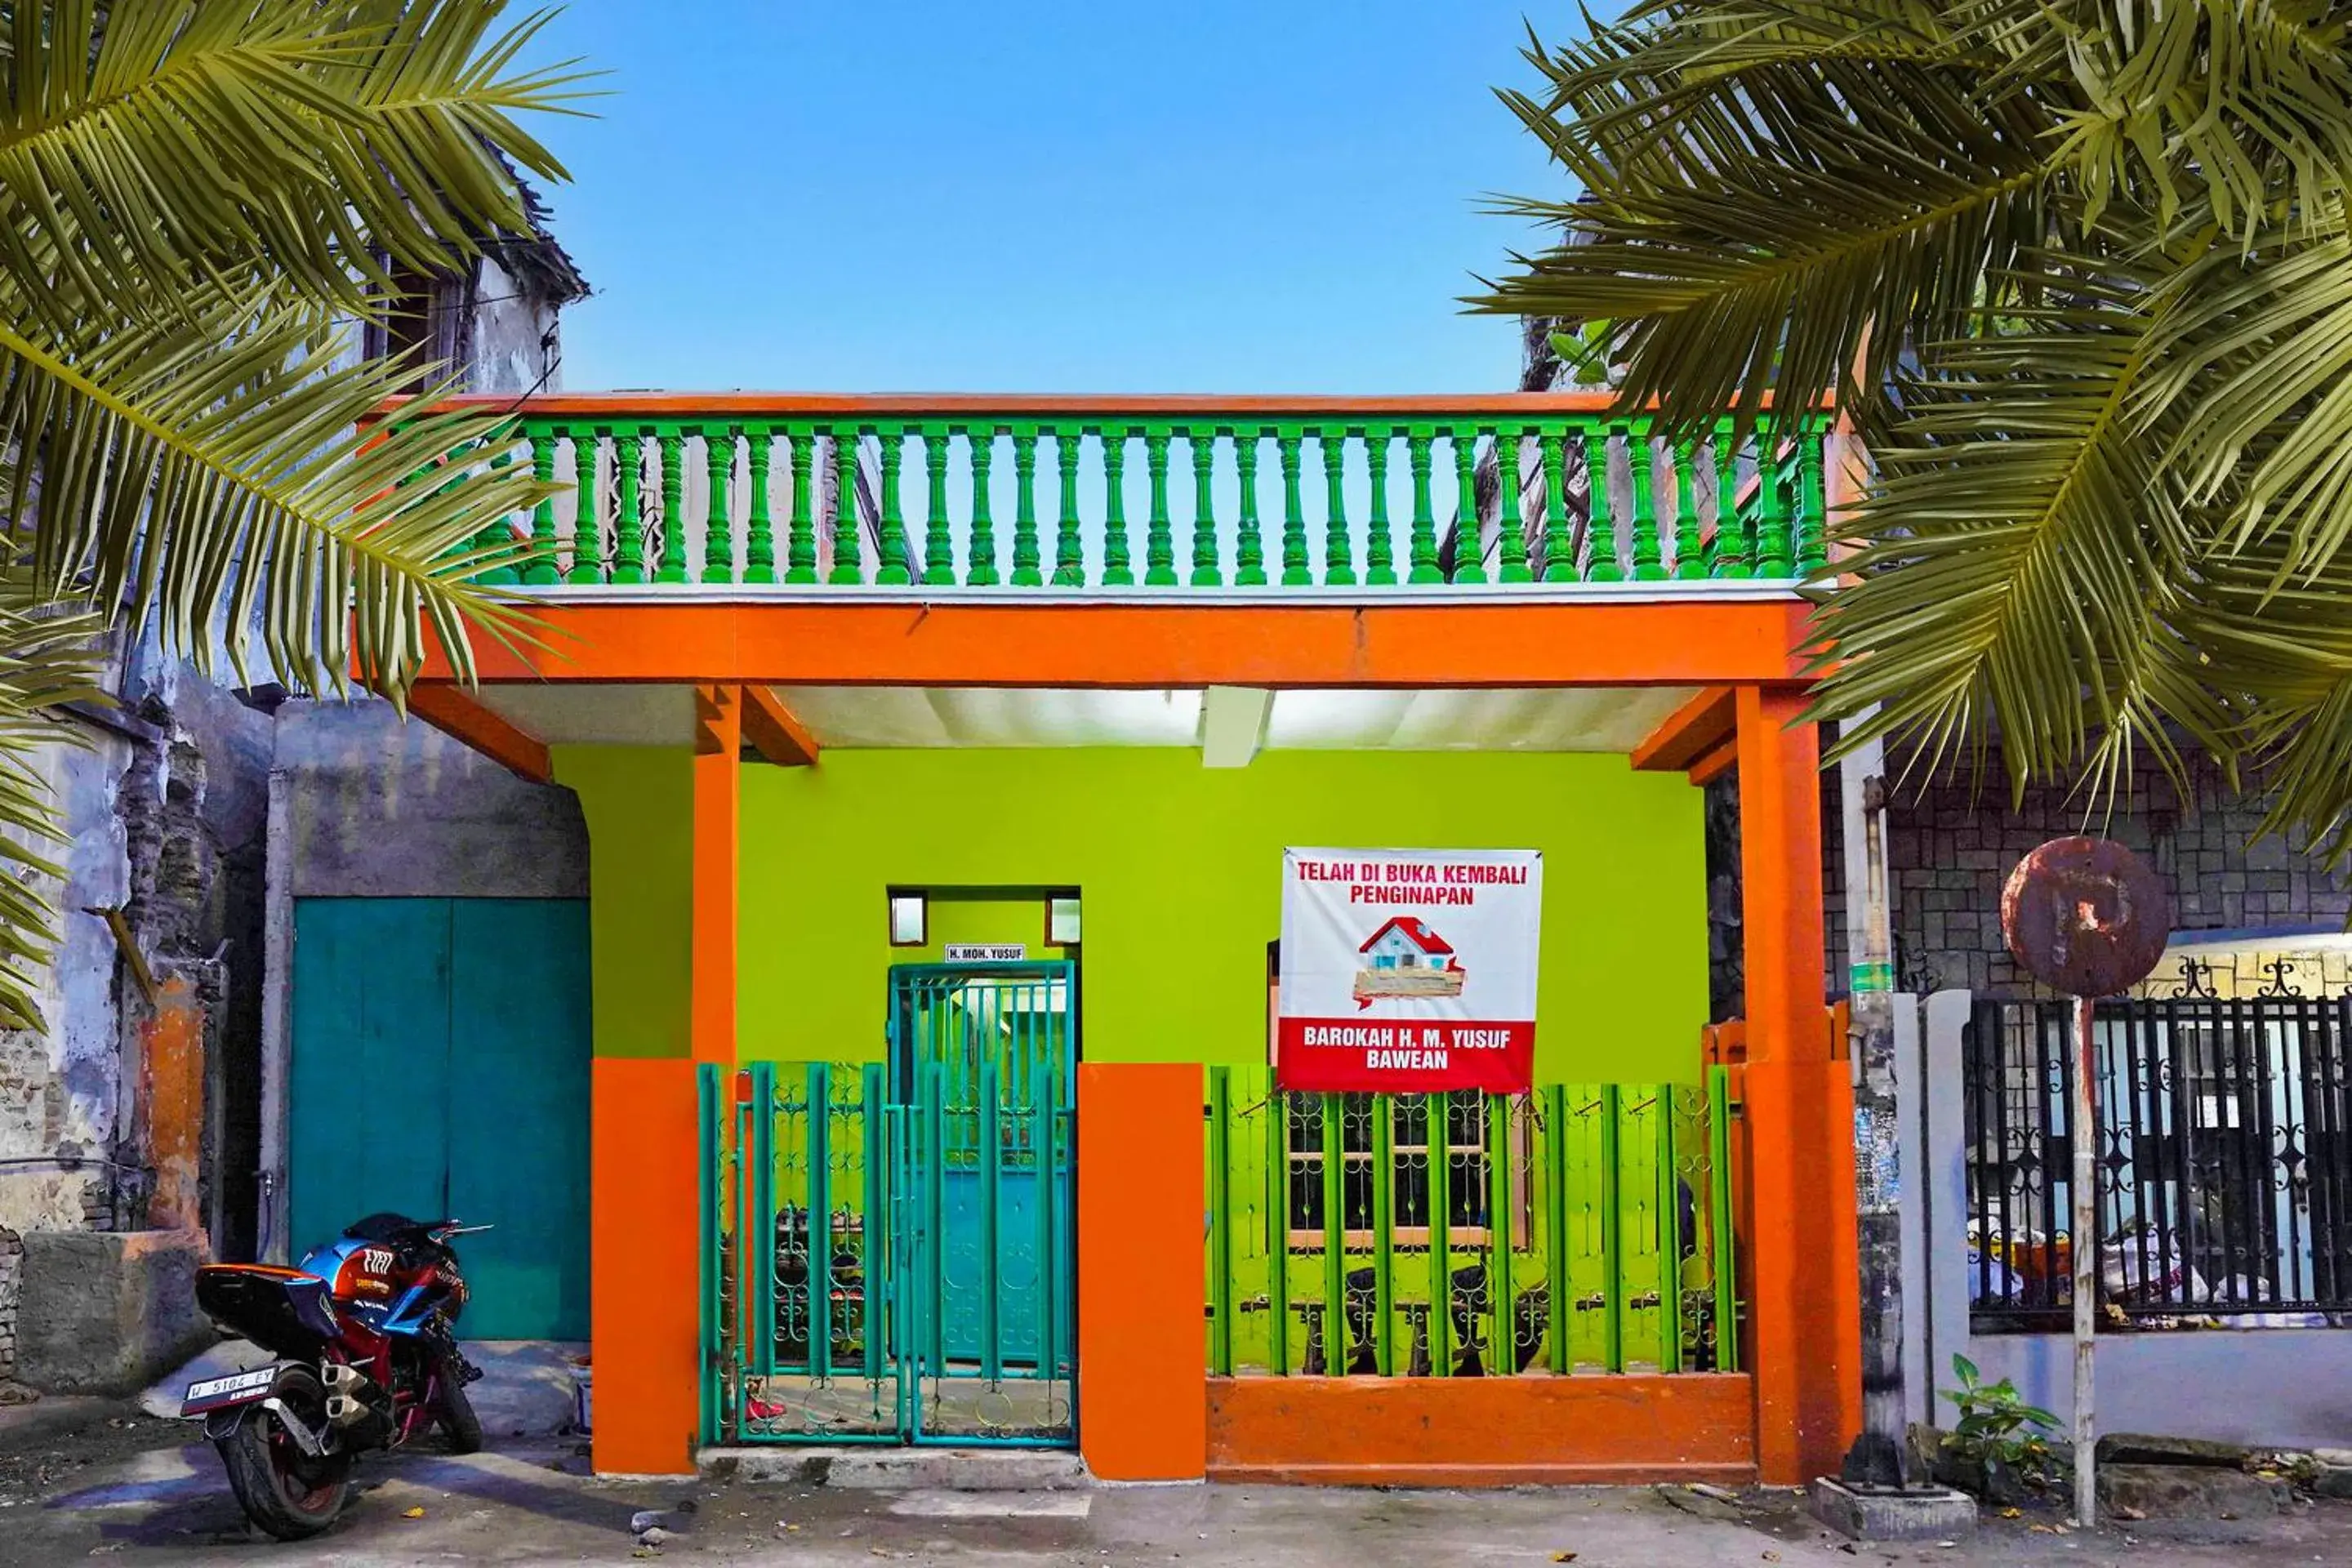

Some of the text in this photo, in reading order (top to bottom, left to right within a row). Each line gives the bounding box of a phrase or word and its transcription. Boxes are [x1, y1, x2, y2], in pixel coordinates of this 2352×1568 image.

[1298, 862, 1526, 884] TELAH DI BUKA KEMBALI
[1350, 884, 1473, 906] PENGINAPAN
[949, 948, 1022, 959] H. MOH. YUSUF
[1304, 1027, 1511, 1049] BAROKAH H. M. YUSUF
[1366, 1049, 1448, 1070] BAWEAN
[363, 1249, 394, 1275] FIAT
